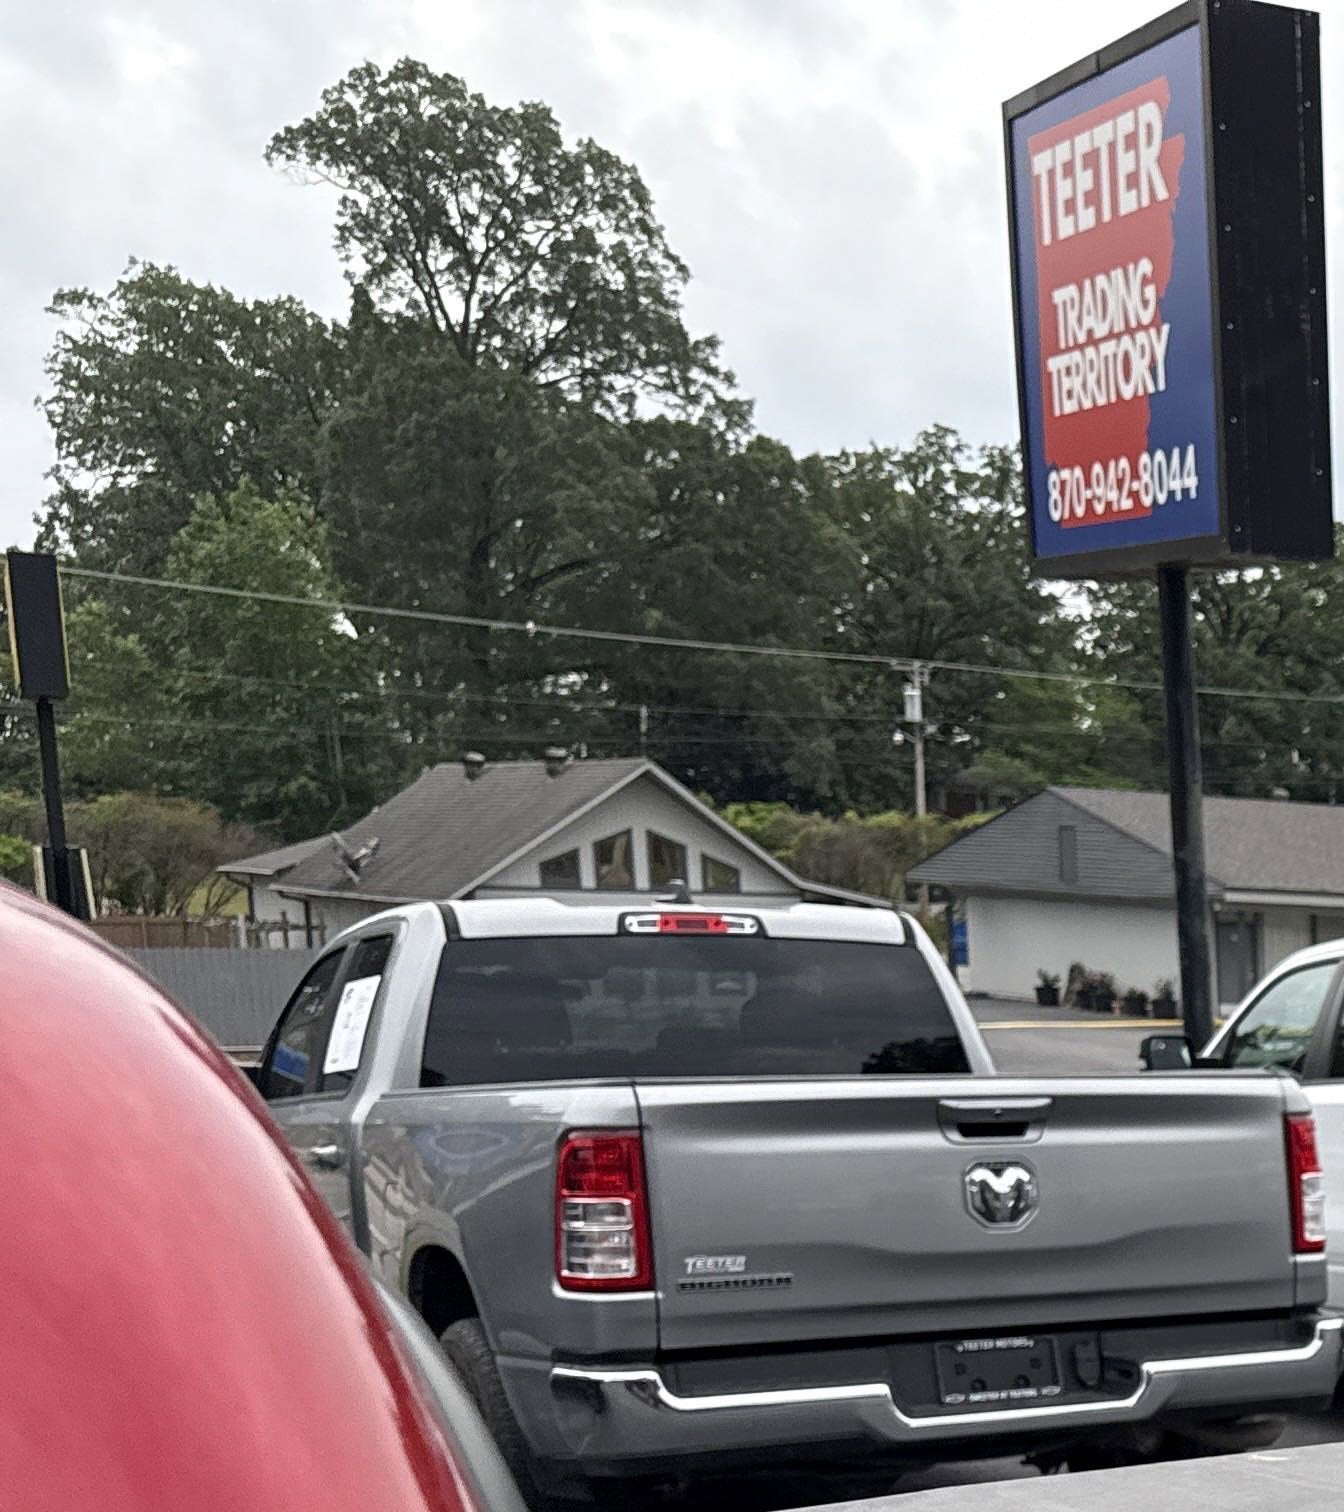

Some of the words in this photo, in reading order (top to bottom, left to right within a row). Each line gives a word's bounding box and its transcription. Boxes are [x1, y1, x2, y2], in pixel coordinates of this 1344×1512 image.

[1032, 100, 1170, 246] TEETER
[1051, 257, 1158, 350] TRADING
[1046, 322, 1171, 418] TERRITORY
[1047, 443, 1199, 523] 870-942-8044
